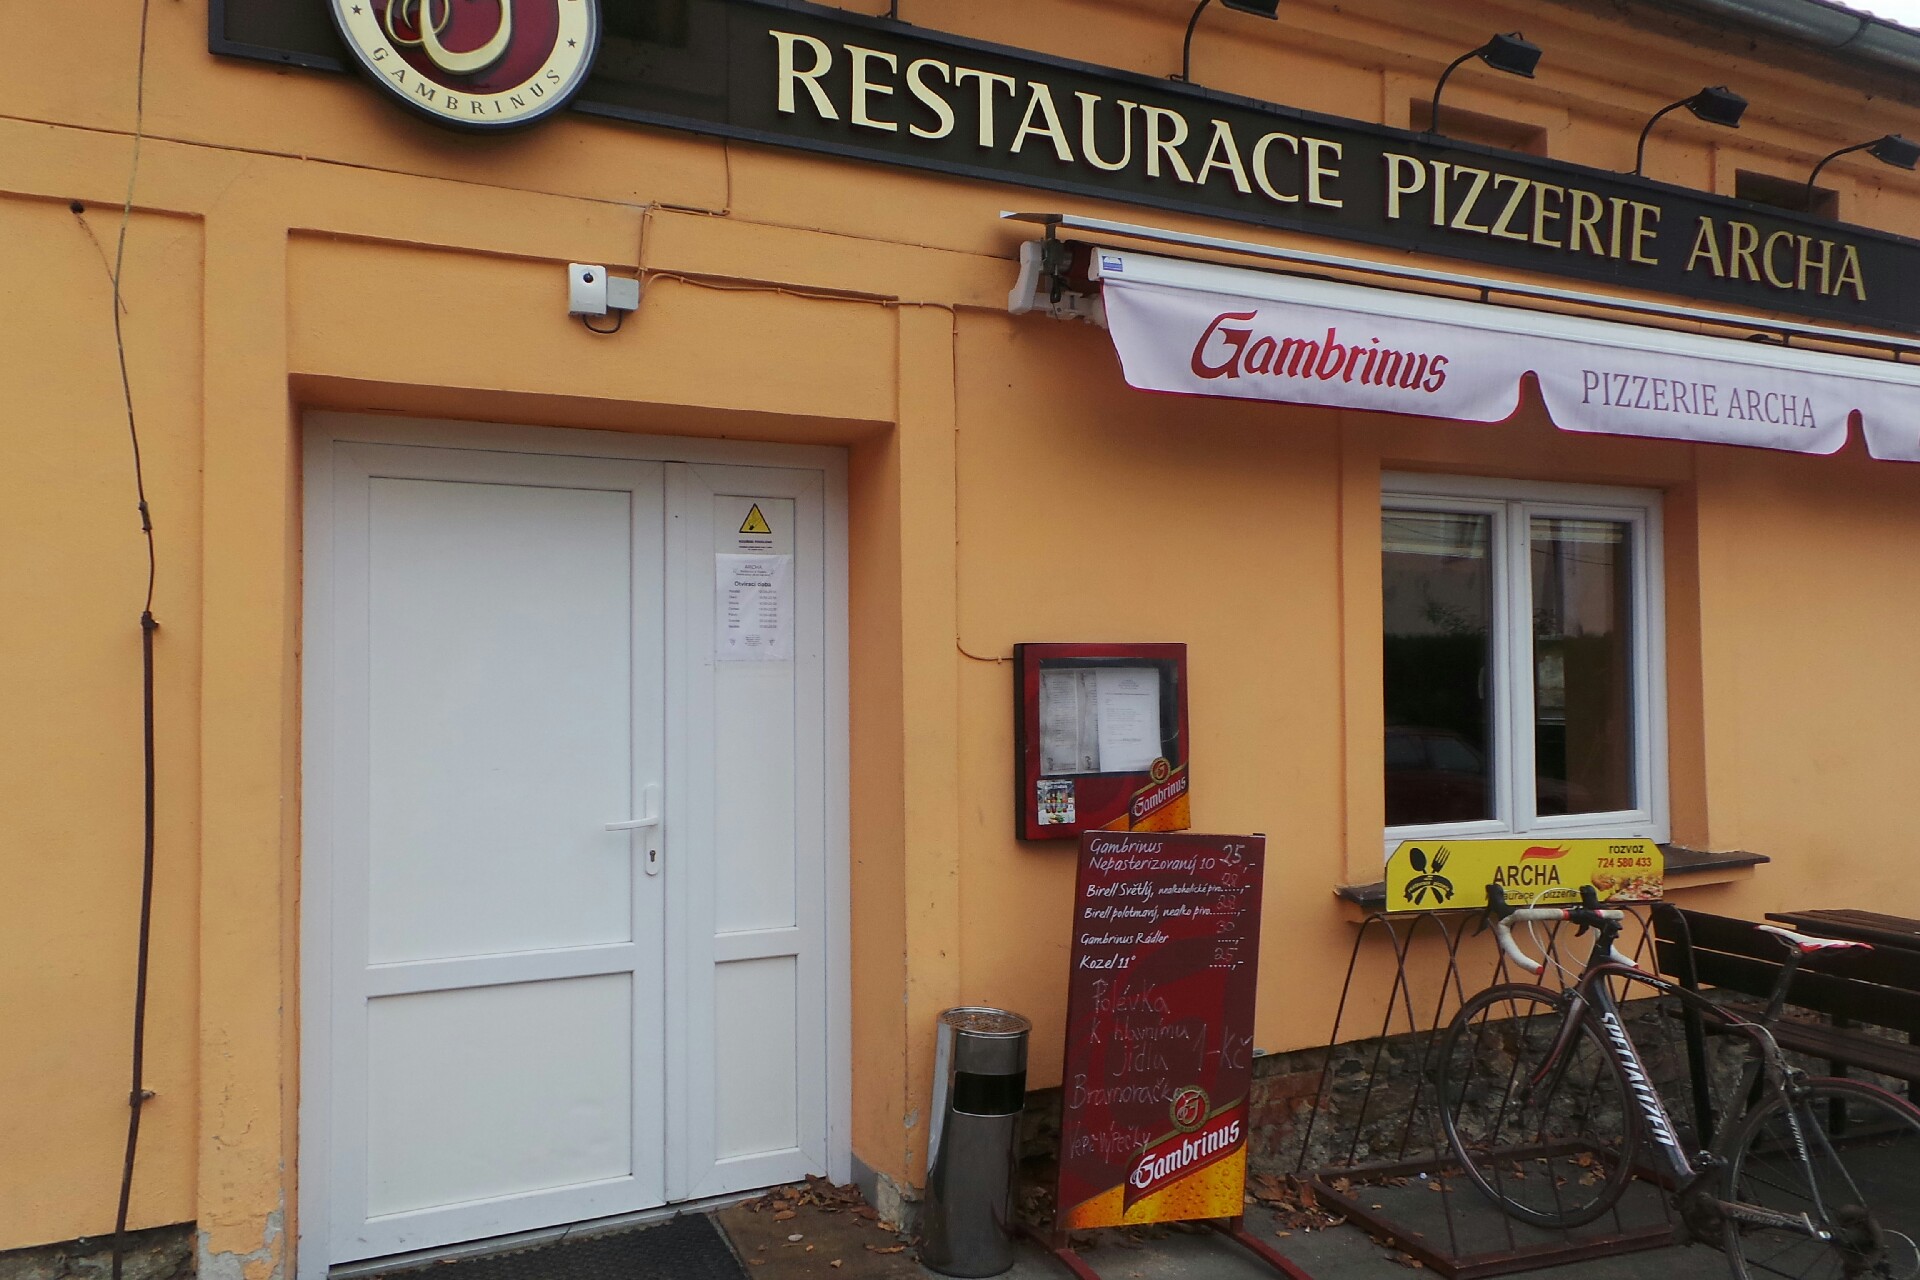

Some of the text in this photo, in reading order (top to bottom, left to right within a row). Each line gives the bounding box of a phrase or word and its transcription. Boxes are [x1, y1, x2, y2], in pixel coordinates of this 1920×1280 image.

[372, 46, 562, 115] GAMBRINUS
[768, 29, 1868, 302] RESTAURACE PIZZERIE ARCHA
[1190, 309, 1450, 394] Gambrinus
[1581, 369, 1818, 429] PIZZERIE ARCHA
[1132, 775, 1187, 818] Gambrinus
[1090, 837, 1163, 853] Gambrinus
[1609, 845, 1644, 854] rozvoz
[1199, 857, 1216, 870] 10
[1597, 857, 1614, 868] 724
[1635, 857, 1653, 867] 433
[1493, 864, 1561, 886] ARCHA
[1086, 882, 1117, 898] Birell
[1084, 905, 1112, 919] Birell
[1080, 933, 1133, 946] Gambrinus
[1079, 954, 1118, 970] Kozel
[1130, 1120, 1240, 1189] Gambrinus
